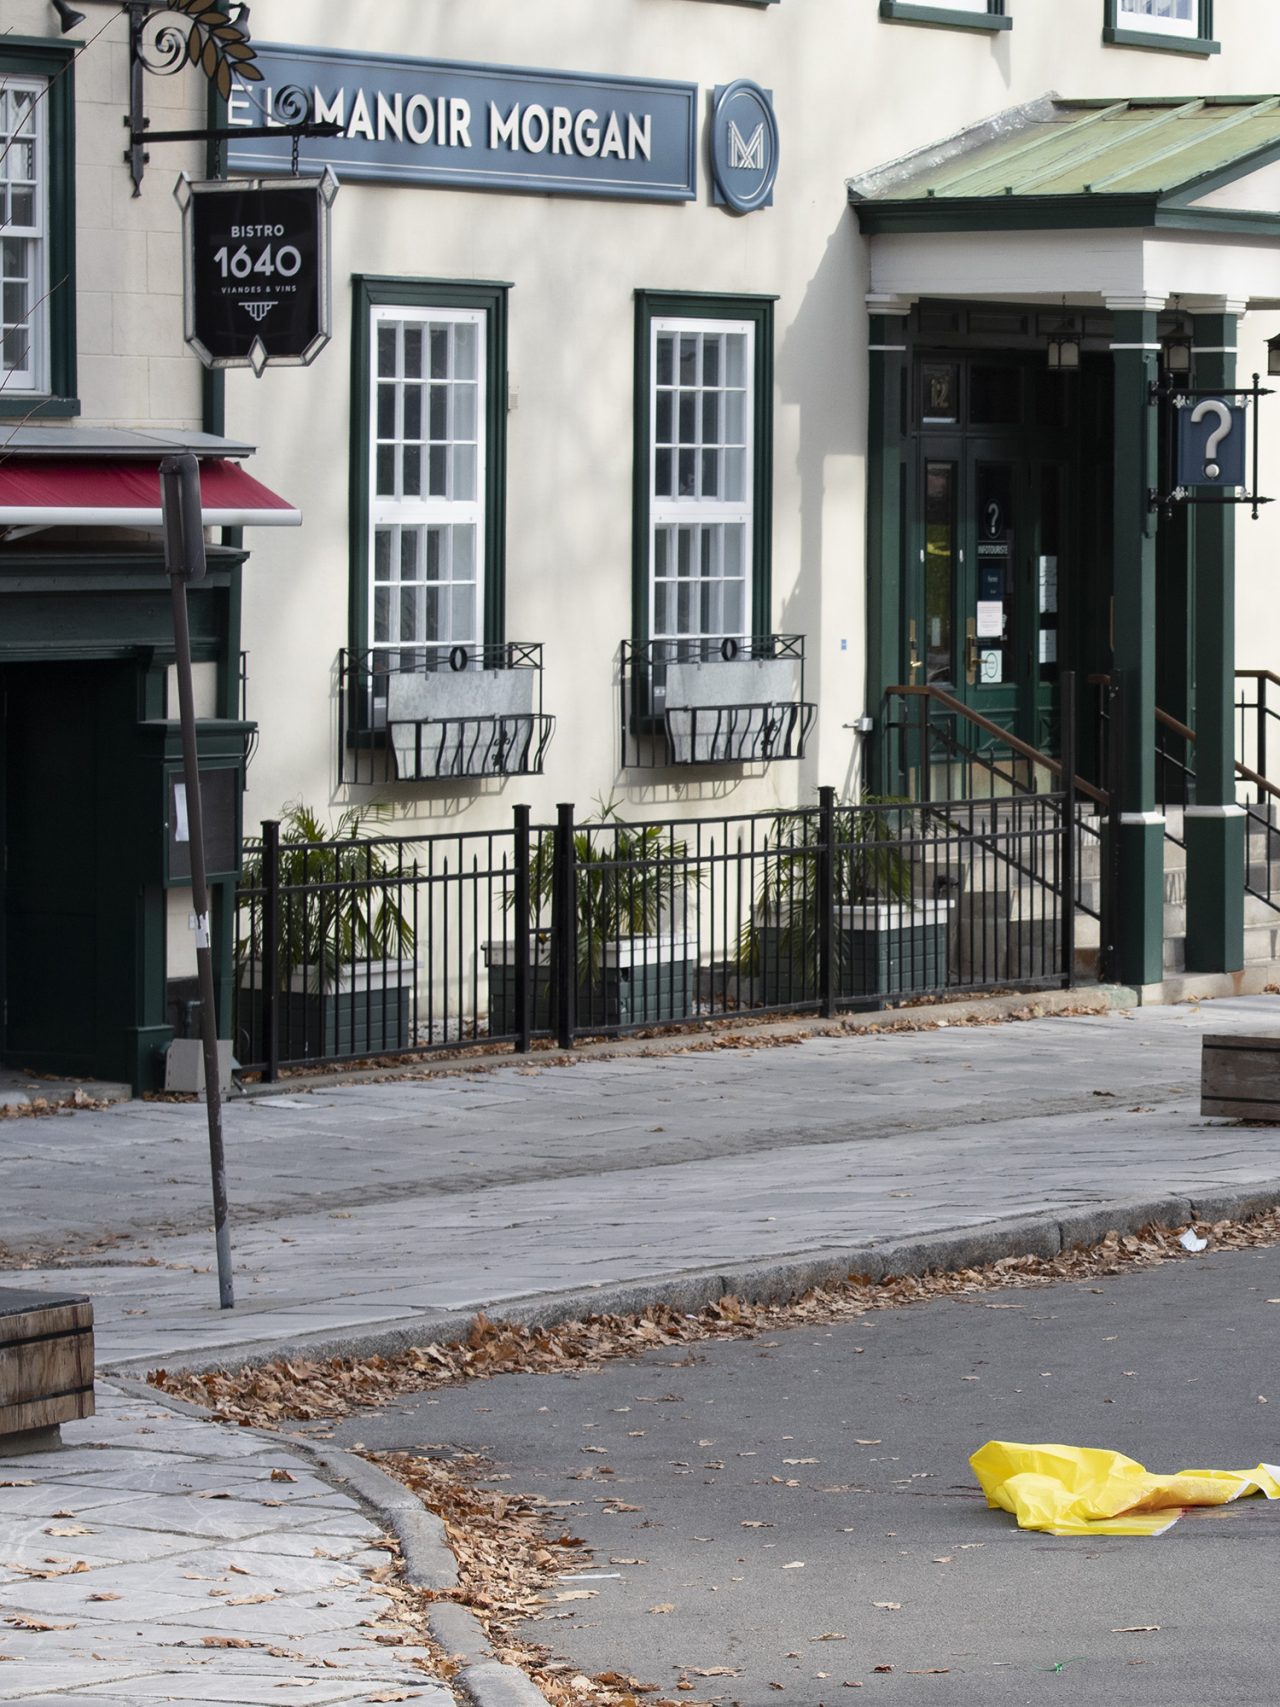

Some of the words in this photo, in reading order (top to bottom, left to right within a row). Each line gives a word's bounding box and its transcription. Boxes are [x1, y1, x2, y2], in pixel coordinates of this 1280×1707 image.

[314, 84, 472, 147] MANOIR
[489, 100, 651, 161] MORGAN
[231, 224, 285, 238] BISTRO
[213, 243, 302, 279] 1640
[221, 286, 262, 294] VIANDES
